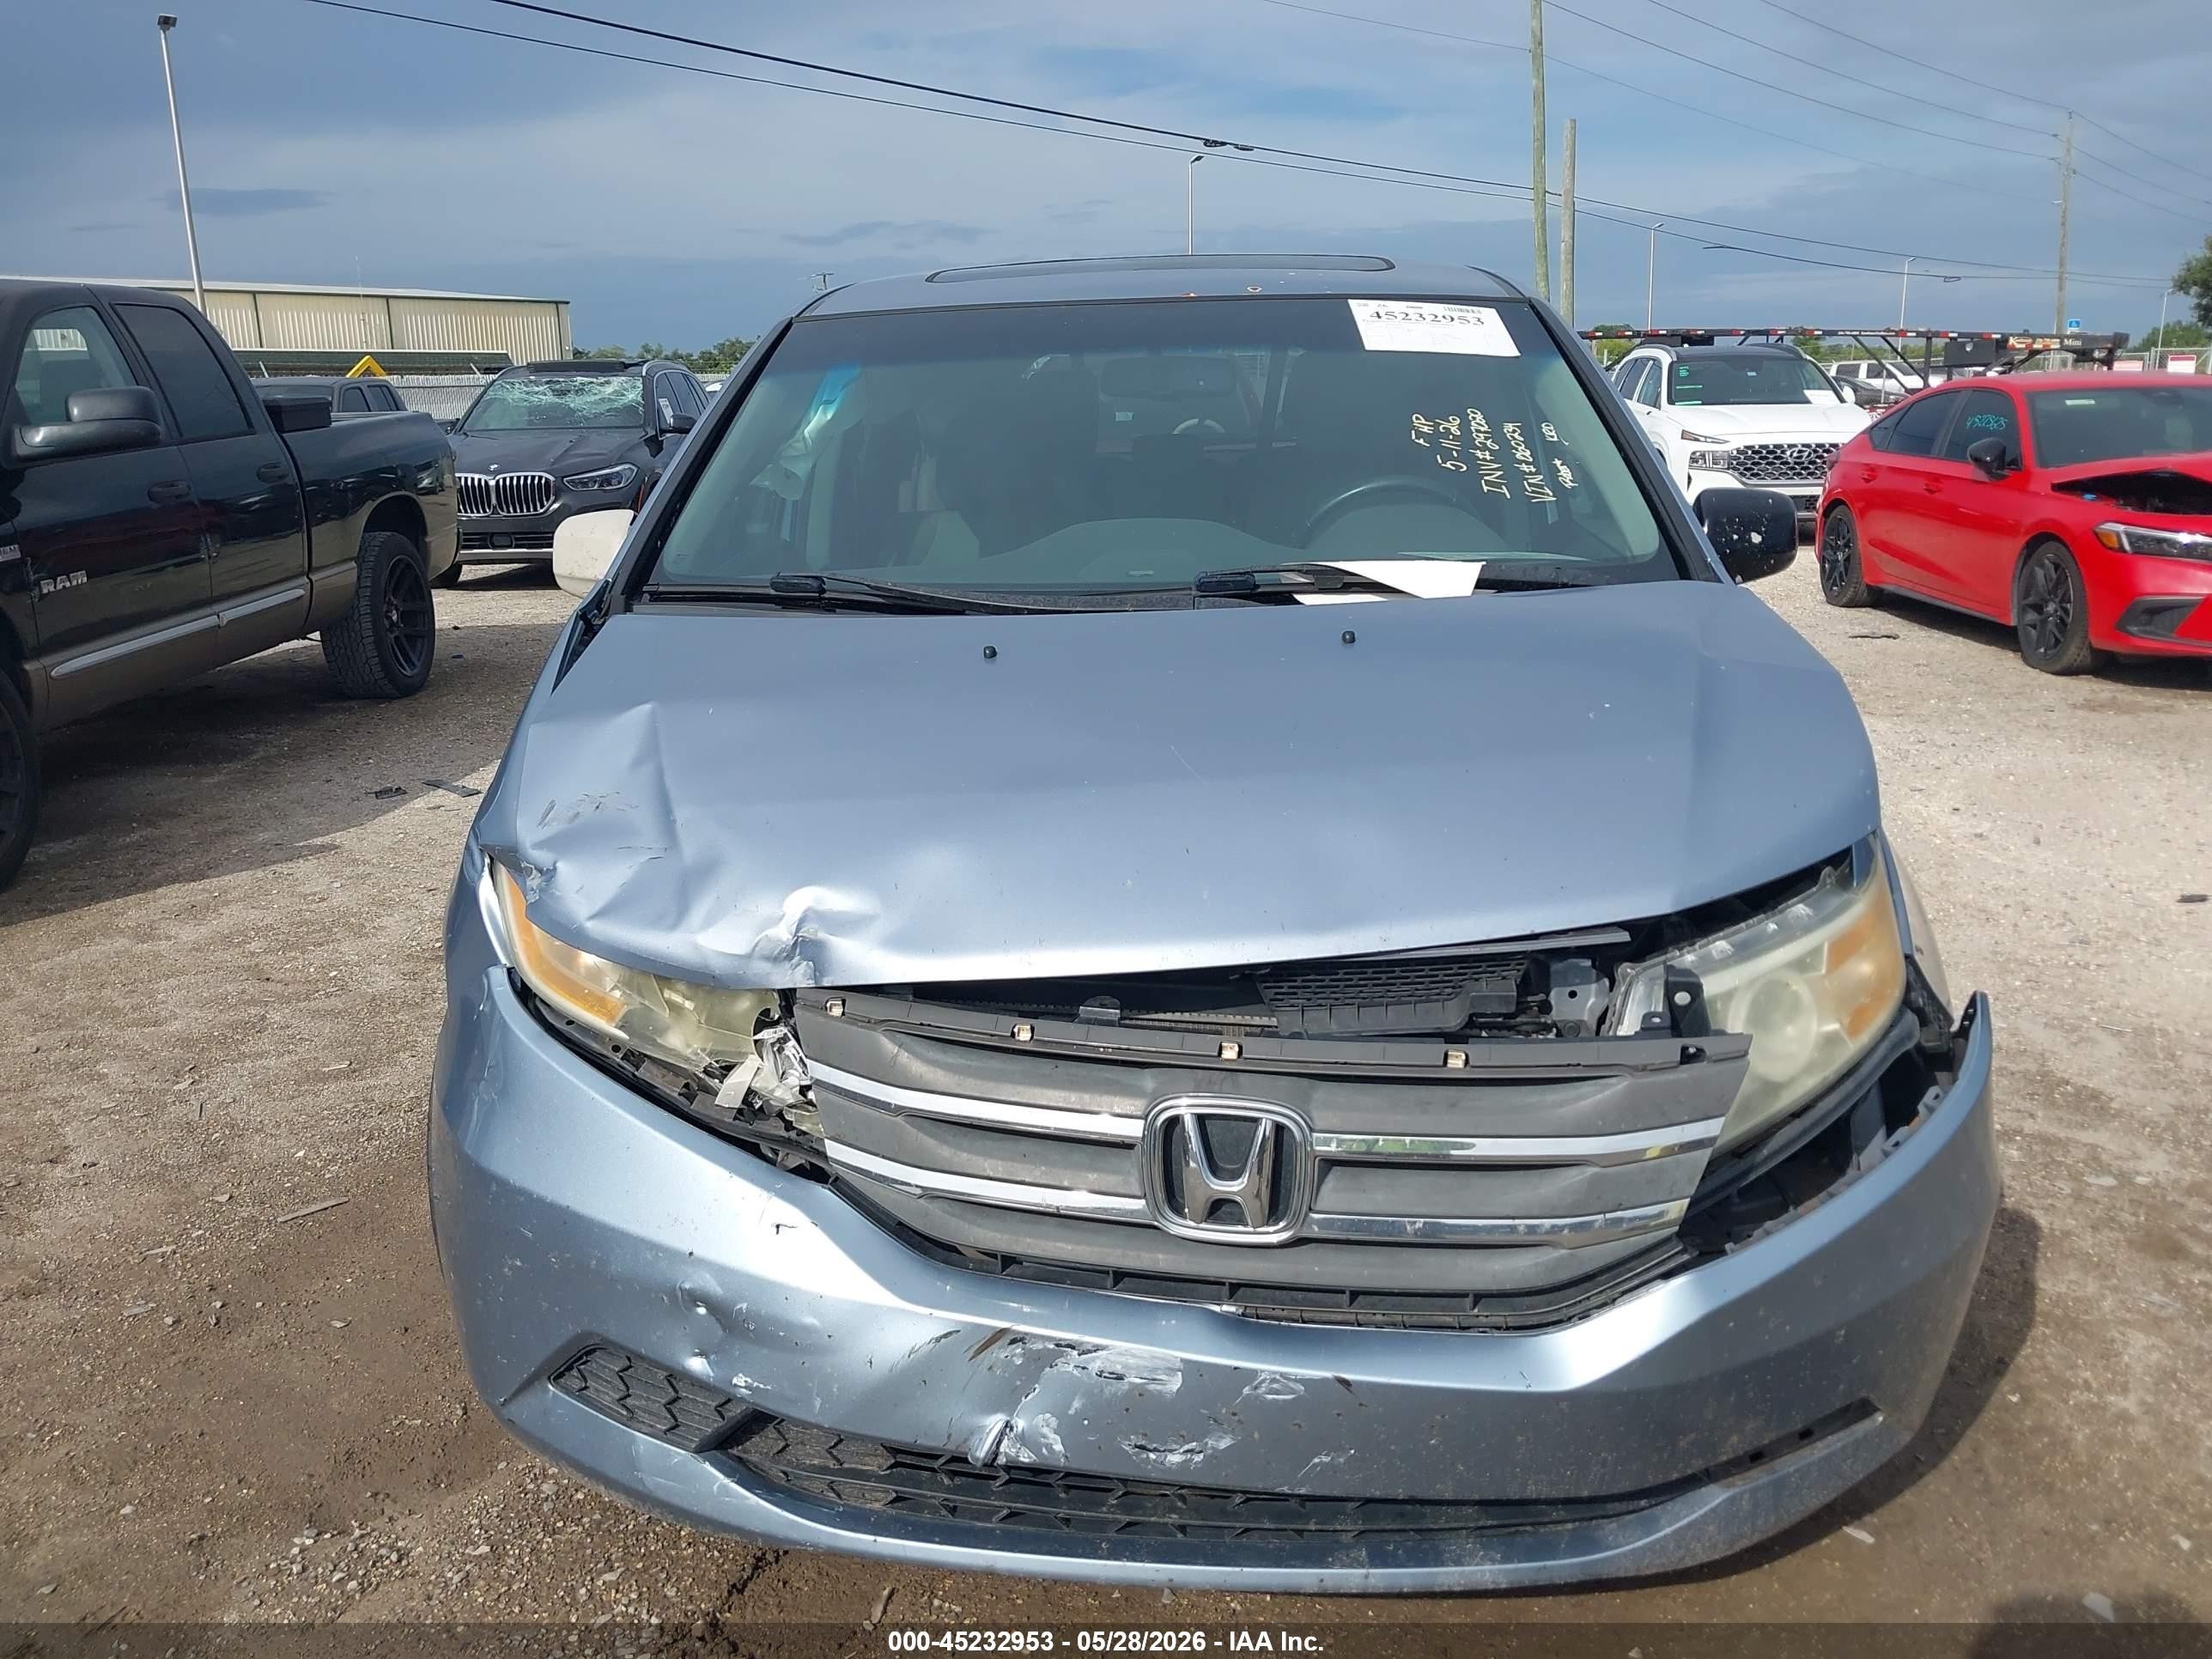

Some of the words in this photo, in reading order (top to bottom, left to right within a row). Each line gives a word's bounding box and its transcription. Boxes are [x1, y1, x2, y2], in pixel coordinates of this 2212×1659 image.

[1370, 310, 1485, 326] 45232953
[1435, 415, 1468, 471] 5-11-26
[40, 569, 88, 595] RAM
